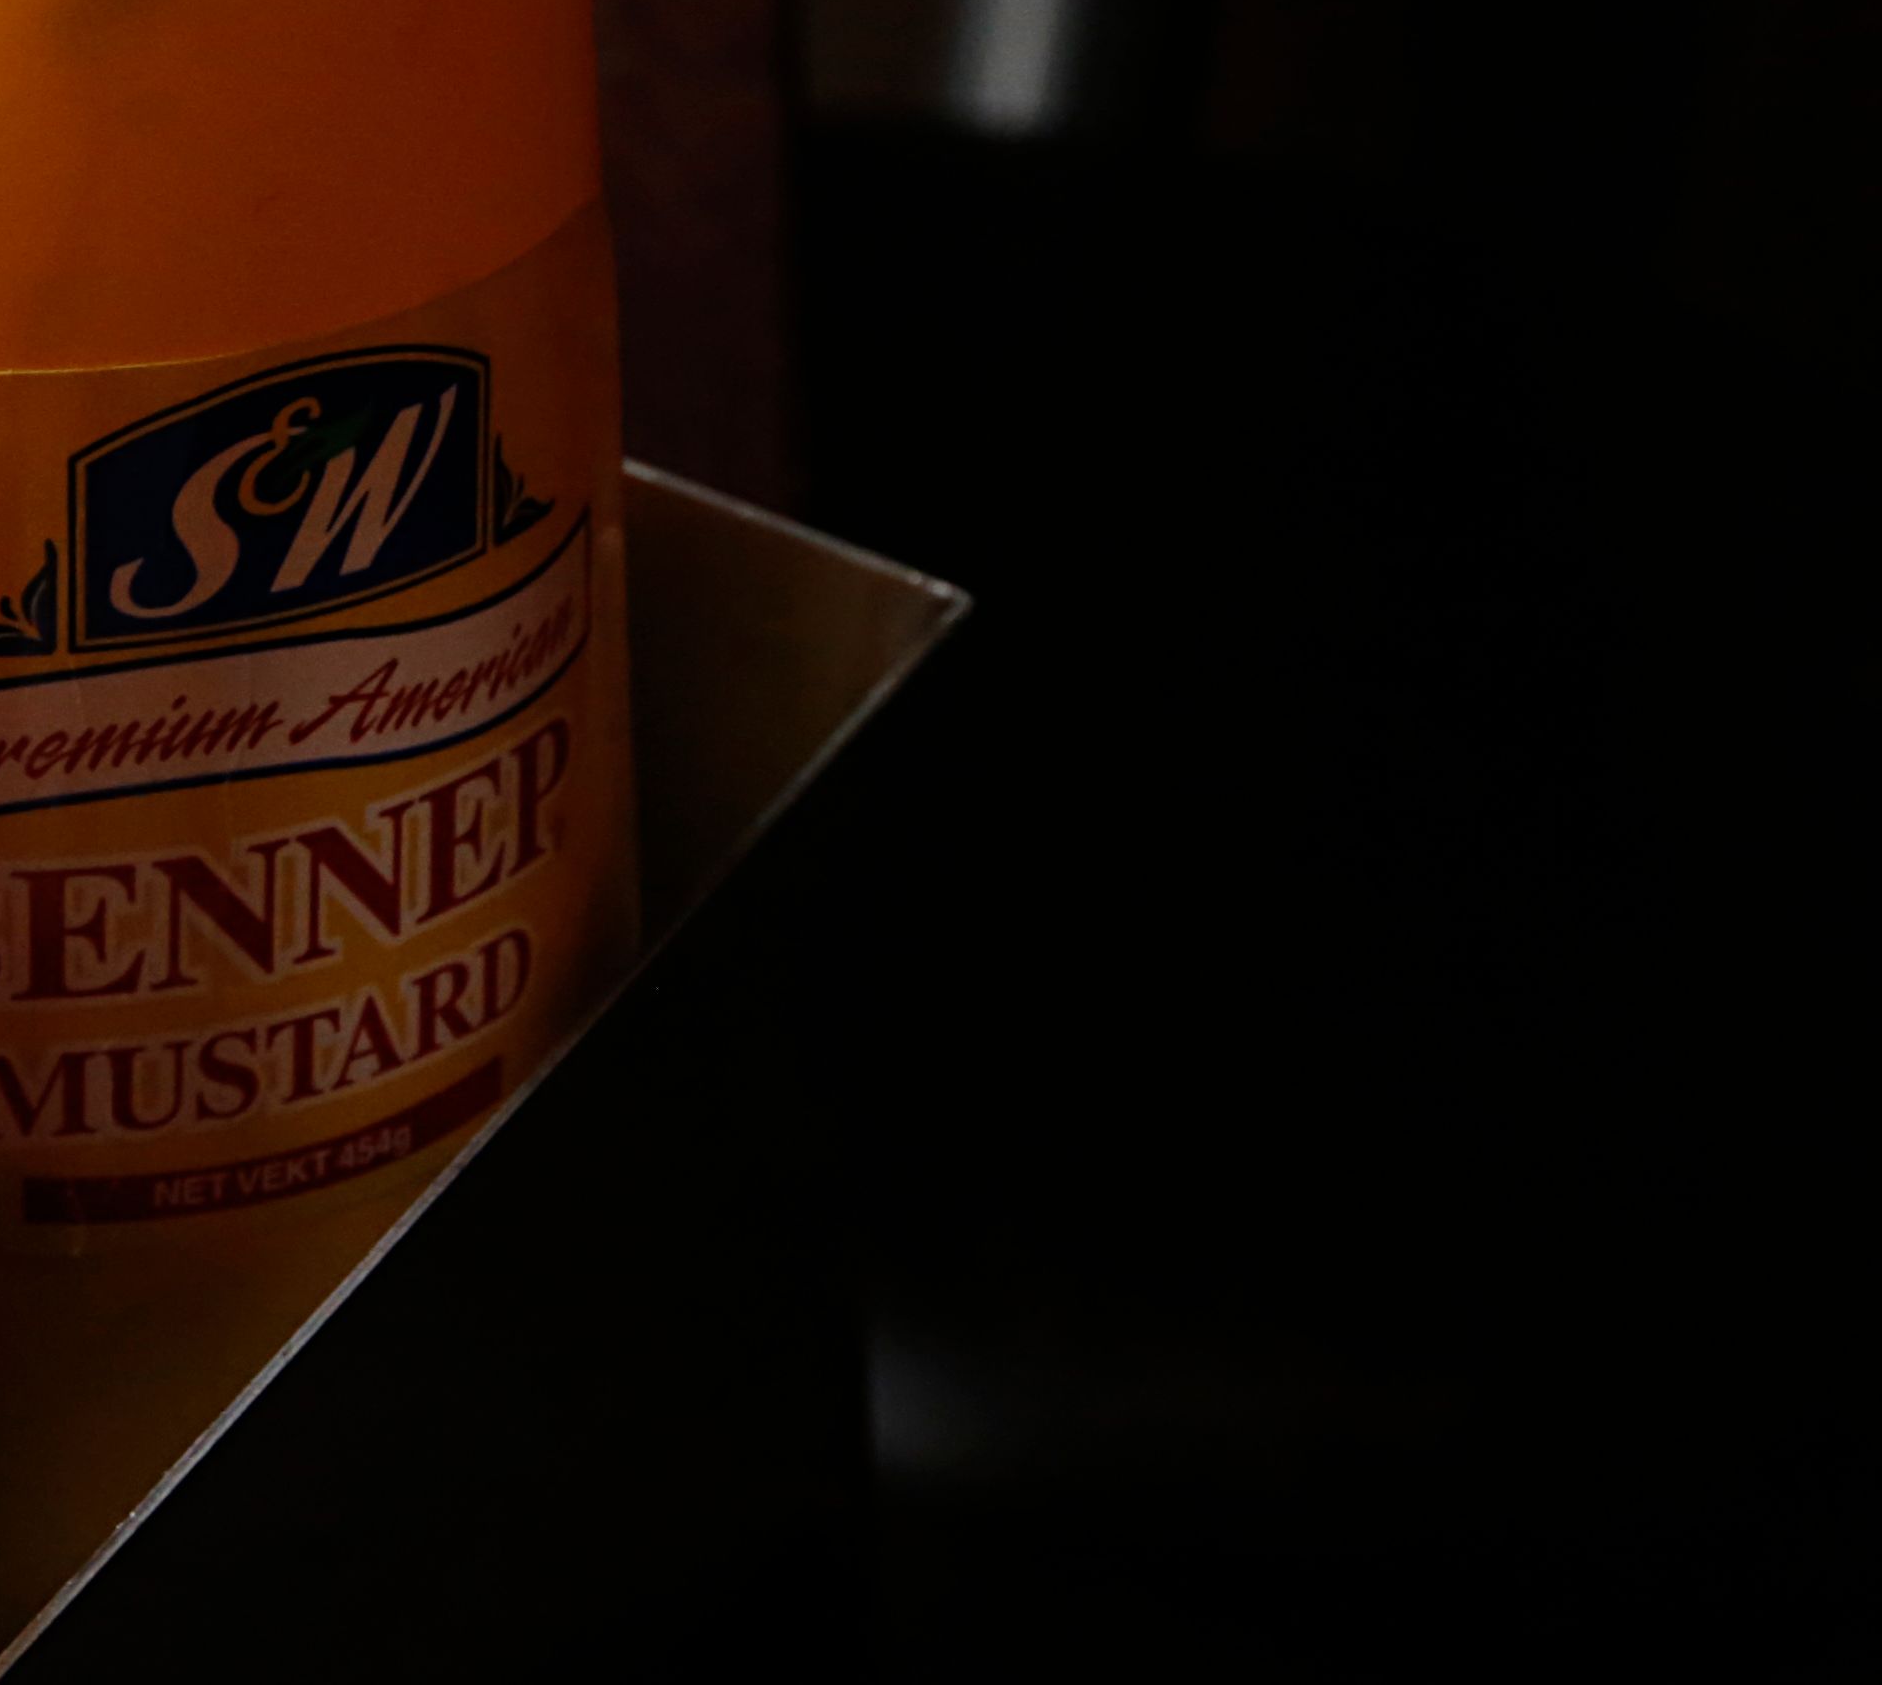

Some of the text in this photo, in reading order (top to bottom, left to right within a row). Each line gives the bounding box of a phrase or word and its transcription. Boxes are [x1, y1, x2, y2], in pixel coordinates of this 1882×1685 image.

[110, 384, 457, 620] S&W
[288, 594, 574, 748] American
[152, 1124, 413, 1208] NET VEKT 454g
